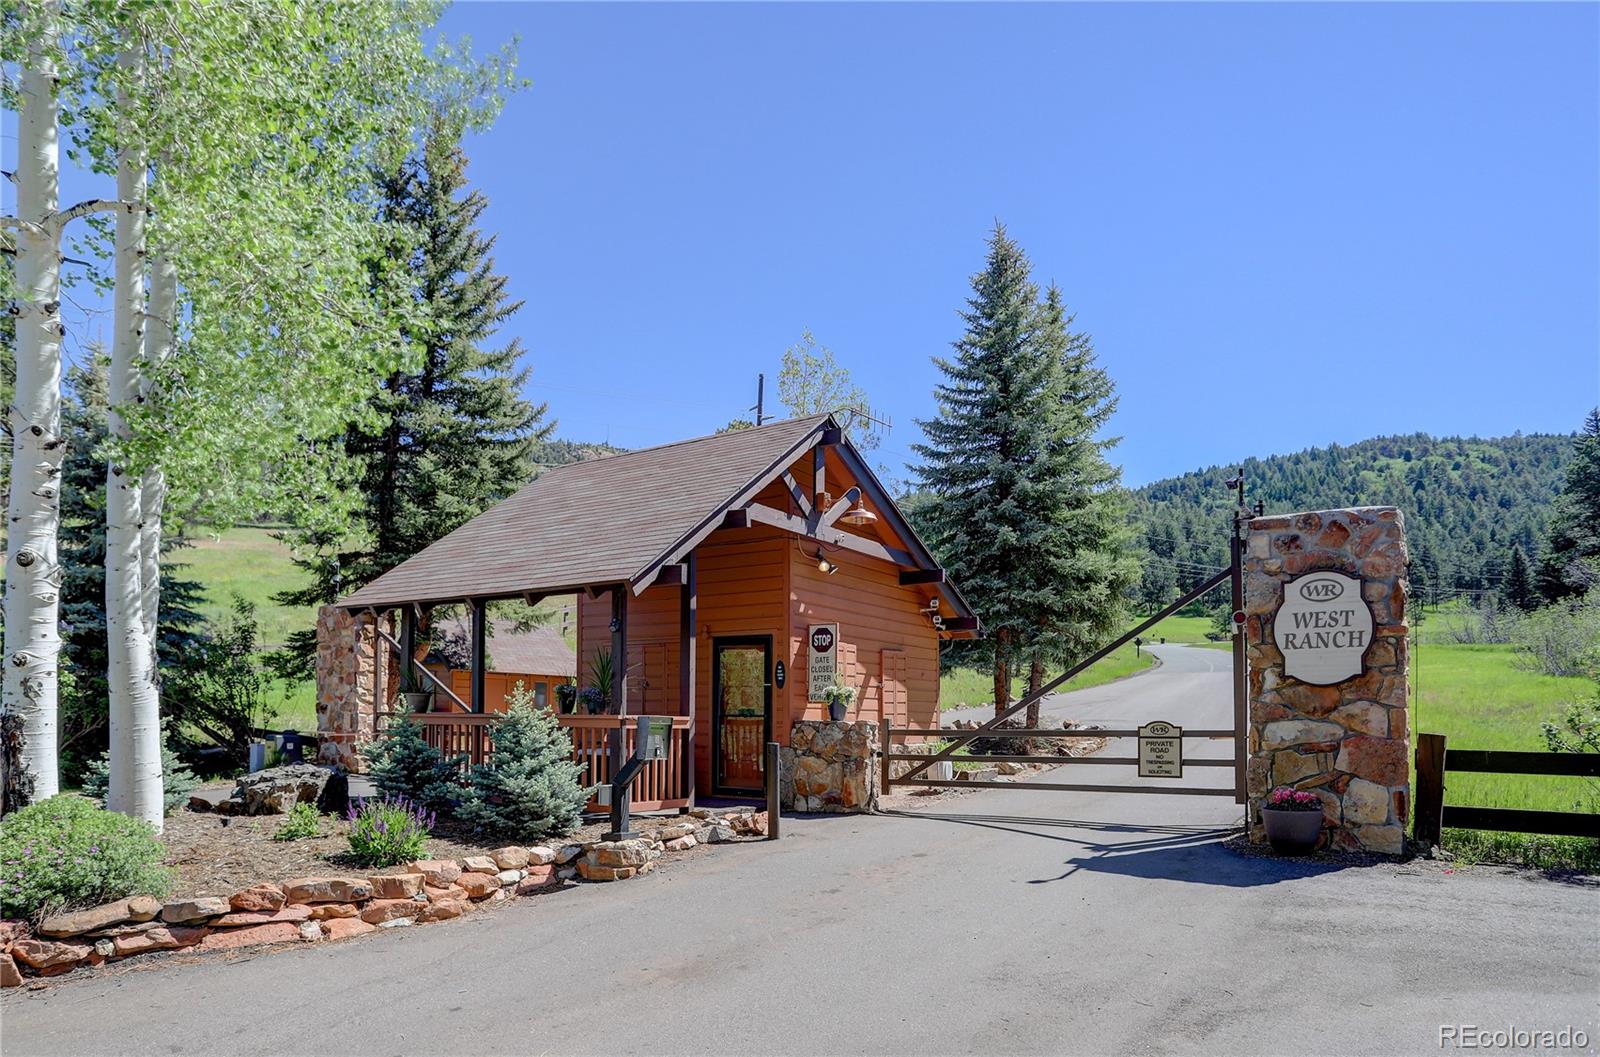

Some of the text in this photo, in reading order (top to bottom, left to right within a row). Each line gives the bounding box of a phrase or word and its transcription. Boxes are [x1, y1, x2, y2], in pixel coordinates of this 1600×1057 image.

[1304, 583, 1338, 597] WR
[1292, 609, 1355, 629] WEST
[813, 634, 832, 646] STOP
[1283, 630, 1366, 650] RANCH
[814, 656, 830, 664] GATE
[812, 674, 832, 683] AFTER
